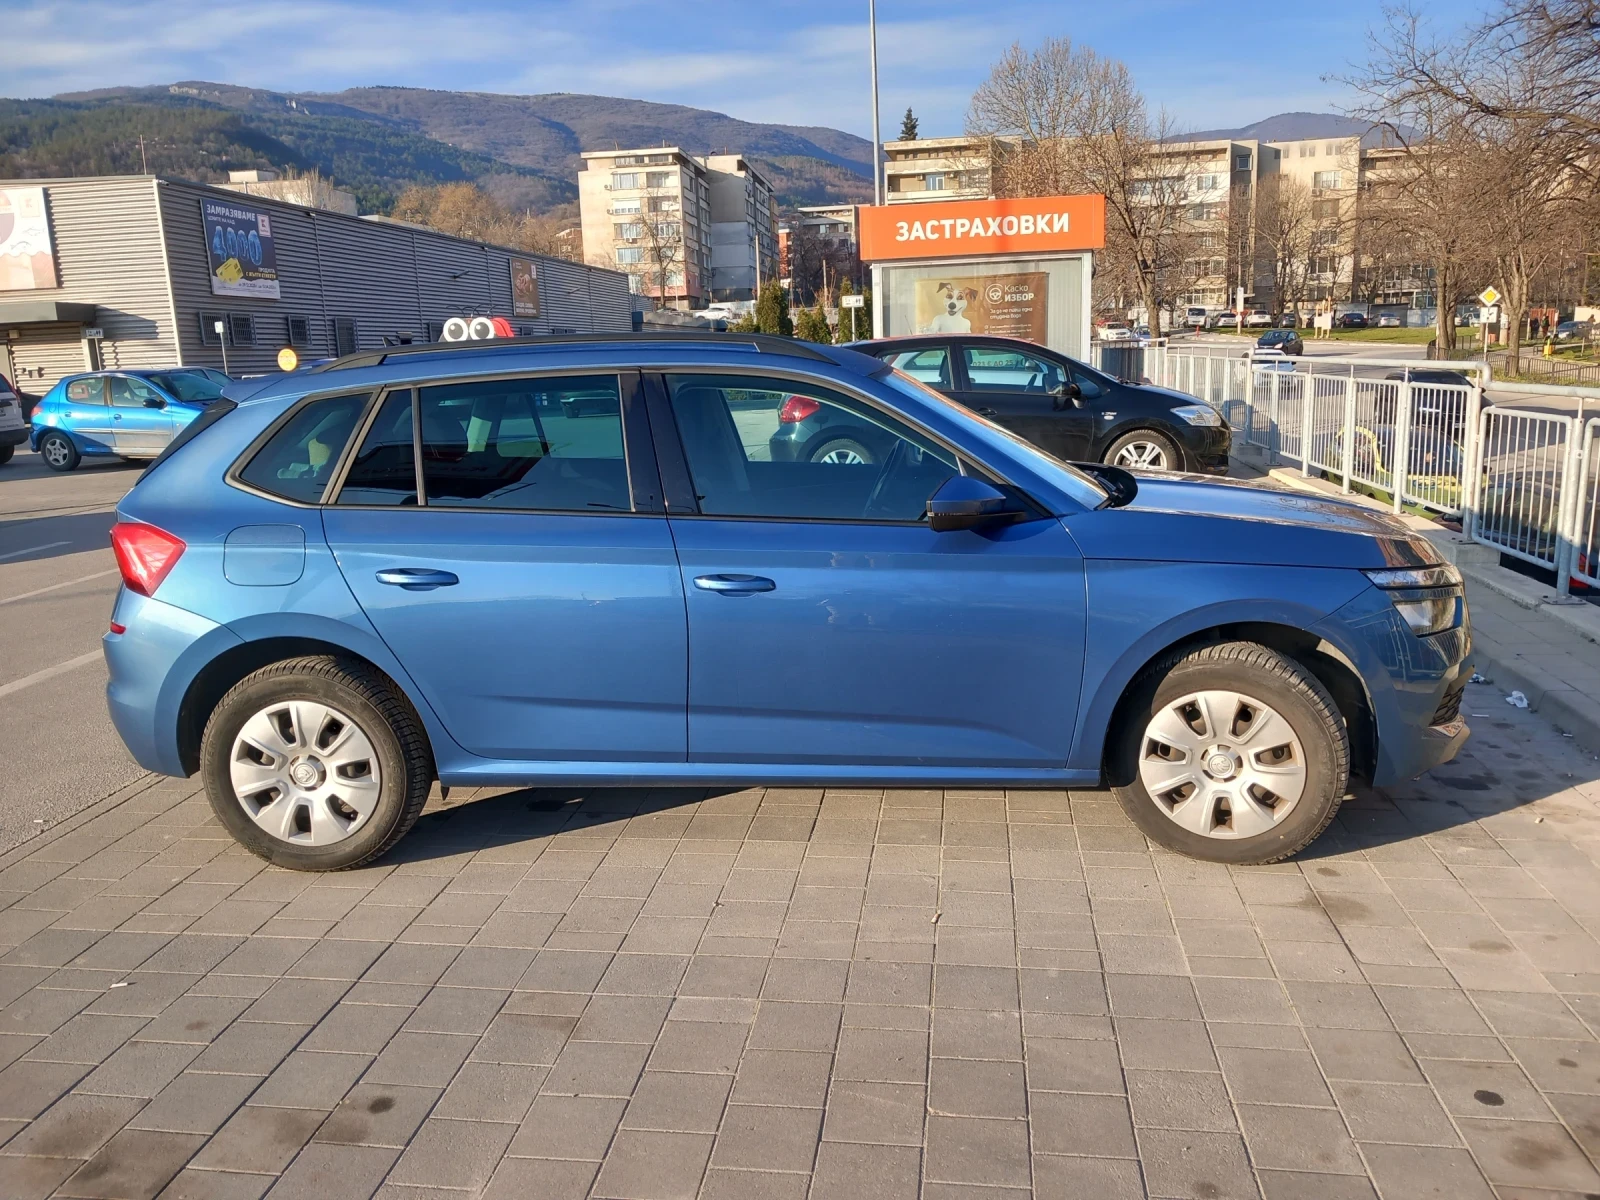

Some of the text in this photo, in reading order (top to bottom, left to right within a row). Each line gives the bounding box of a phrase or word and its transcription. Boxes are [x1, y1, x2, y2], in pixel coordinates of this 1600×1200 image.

[206, 204, 256, 222] ЗАМРАЗЯВАМЕ
[895, 212, 1070, 242] ЗАСТРАХОВКИ
[213, 225, 262, 266] 4000
[1004, 284, 1029, 293] Каско
[1004, 292, 1035, 302] ИЗБОР
